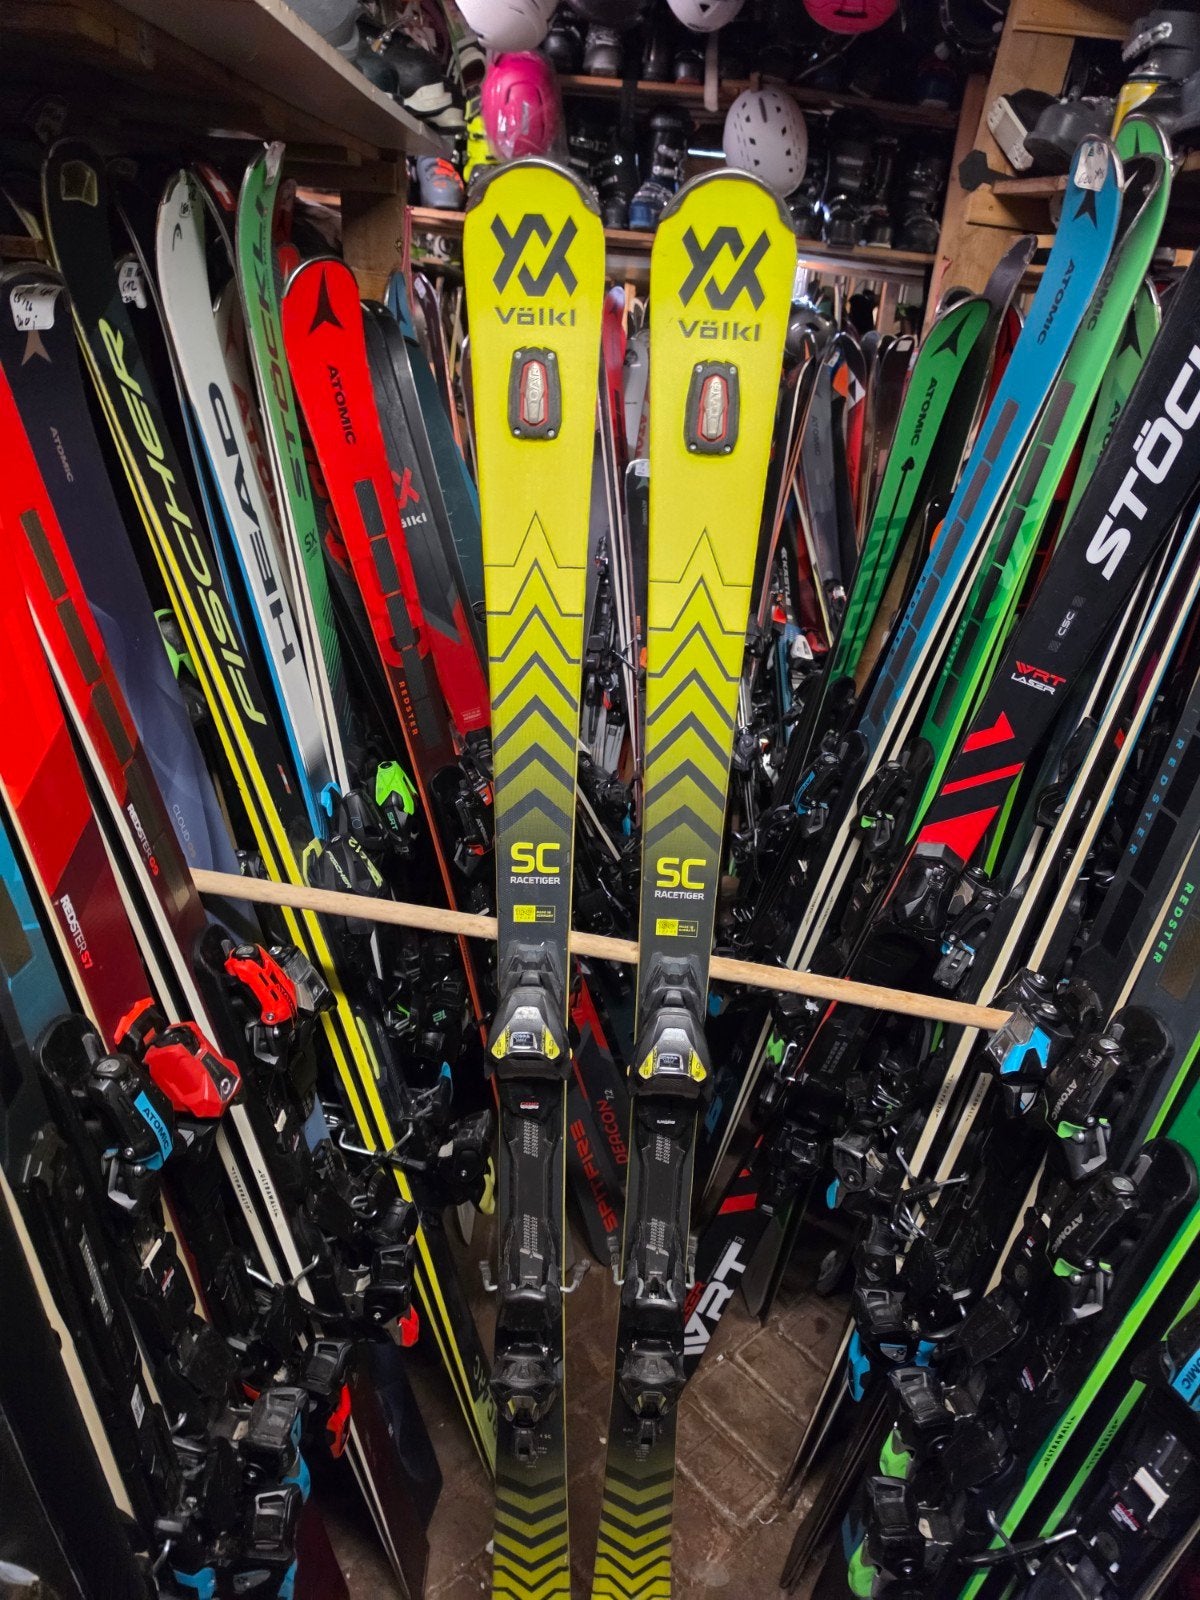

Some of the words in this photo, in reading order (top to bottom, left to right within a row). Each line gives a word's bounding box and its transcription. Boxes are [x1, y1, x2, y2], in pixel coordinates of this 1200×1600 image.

[494, 306, 576, 327] Völkl
[1037, 258, 1076, 346] ATOMIC
[677, 319, 761, 342] Völkl
[327, 364, 356, 445] ATOMIC
[910, 376, 938, 446] ATOMIC
[50, 425, 74, 482] ATOMIC
[98, 318, 267, 725] FISCHER
[208, 381, 296, 666] HEAD
[1057, 611, 1076, 636] CSC
[1010, 672, 1056, 696] LASER
[1015, 660, 1067, 686] WRT
[398, 680, 420, 736] REDSTER
[1128, 737, 1185, 855] REDSTER
[126, 803, 152, 858] REDSTER
[172, 803, 190, 843] CLOUD
[325, 849, 352, 889] FISCHER
[510, 841, 560, 874] SC
[656, 857, 707, 890] SC
[509, 876, 561, 885] RACETIGER
[654, 890, 705, 900] RACETIGER
[60, 894, 88, 954] REDSTER
[80, 950, 94, 970] S7
[1153, 882, 1195, 964] REDSTER
[1052, 1078, 1078, 1121] ATOMIC
[142, 1107, 169, 1150] ATOMIC
[597, 1099, 628, 1164] DEACON
[260, 1174, 277, 1213] ULTRAWALL
[569, 1118, 619, 1233] SPITFIRE
[1052, 1212, 1084, 1254] ATOMIC
[1048, 1421, 1073, 1463] ULTRAWALL
